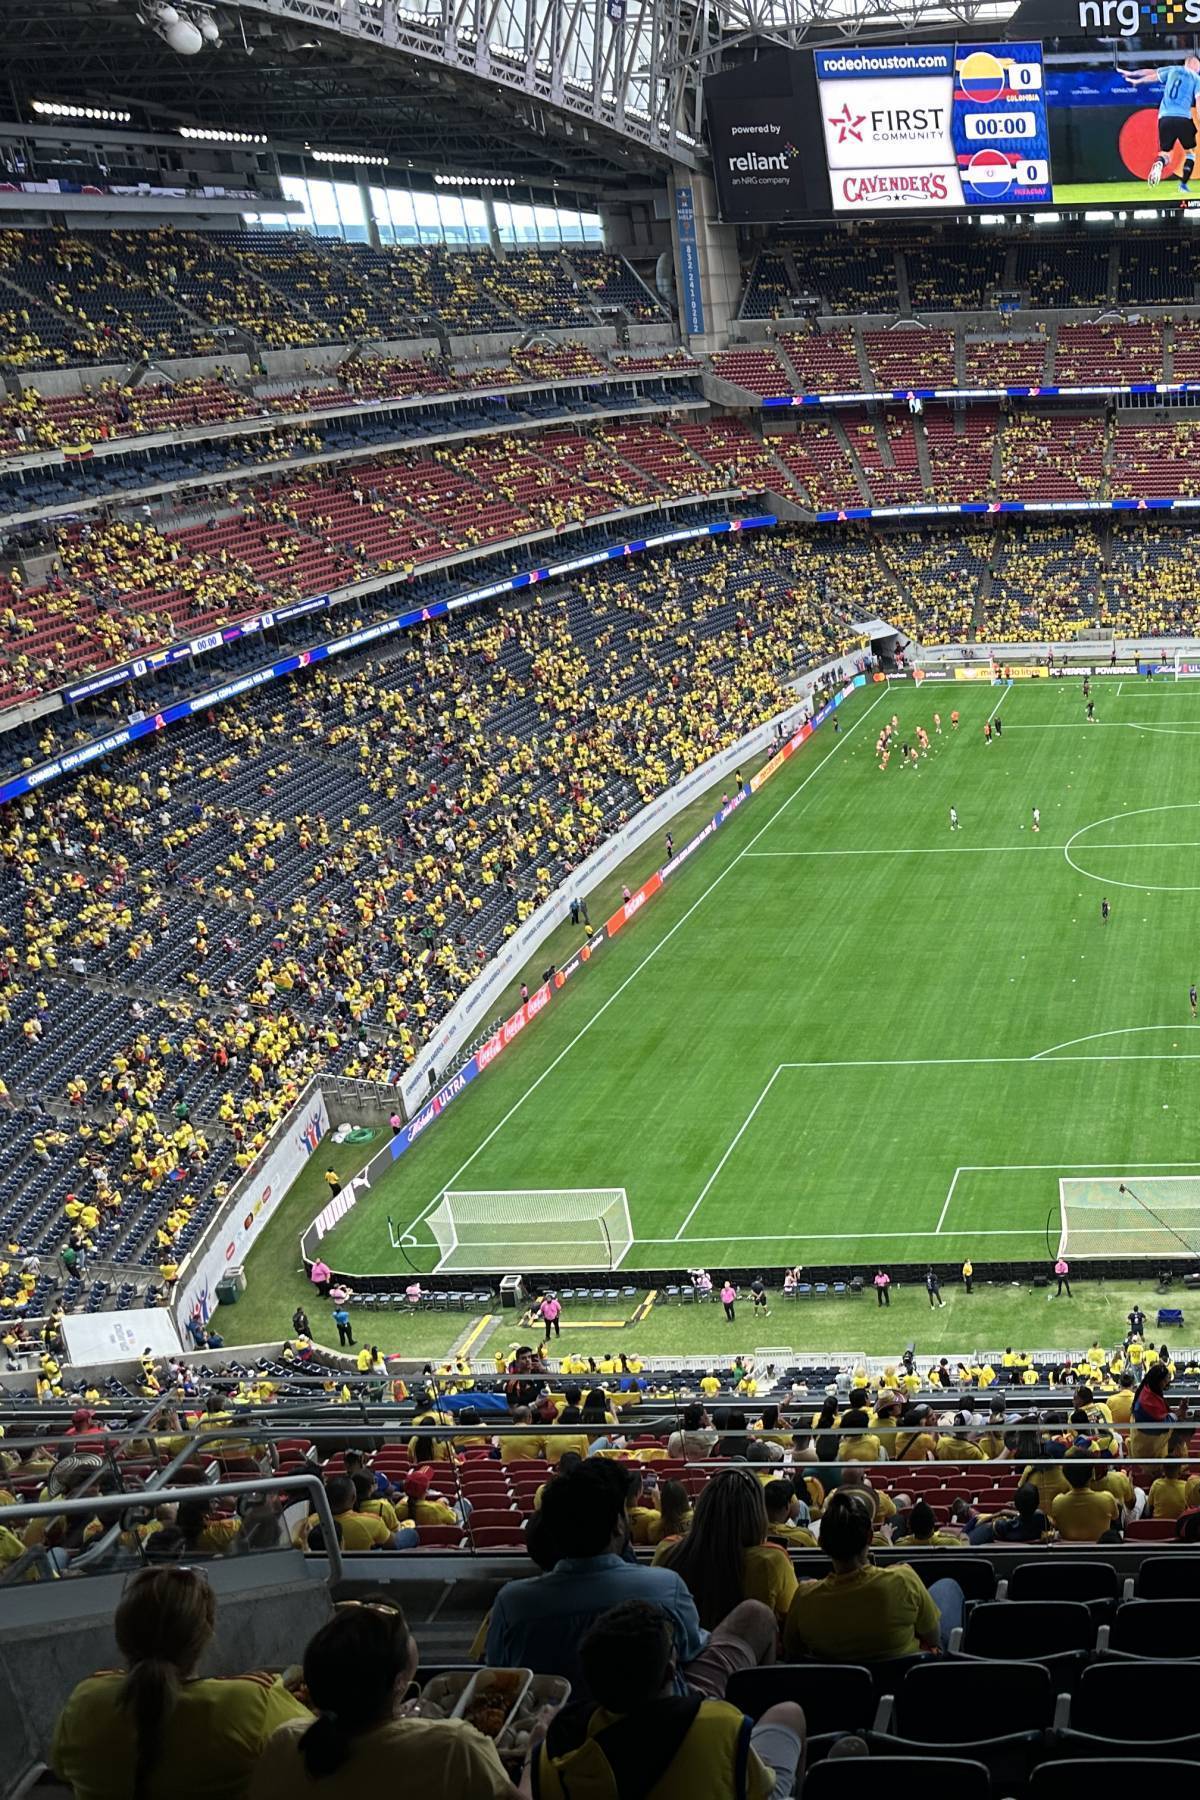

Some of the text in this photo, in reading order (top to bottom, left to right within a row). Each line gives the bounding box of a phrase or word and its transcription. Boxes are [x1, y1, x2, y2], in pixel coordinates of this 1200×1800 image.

[1079, 0, 1140, 36] nrg
[822, 54, 948, 72] rodeohouston.com
[1020, 69, 1031, 84] 0
[1006, 94, 1040, 102] COLOMBIA
[872, 108, 944, 130] FIRST
[975, 118, 1027, 135] 00:00
[731, 123, 781, 136] powered by
[872, 131, 944, 141] COMMUNITY
[728, 152, 788, 171] reliant
[744, 176, 759, 185] NRG
[761, 175, 791, 185] company
[1027, 166, 1038, 180] 0
[843, 172, 949, 203] CAVENDER'S
[438, 1074, 466, 1107] ULTRA
